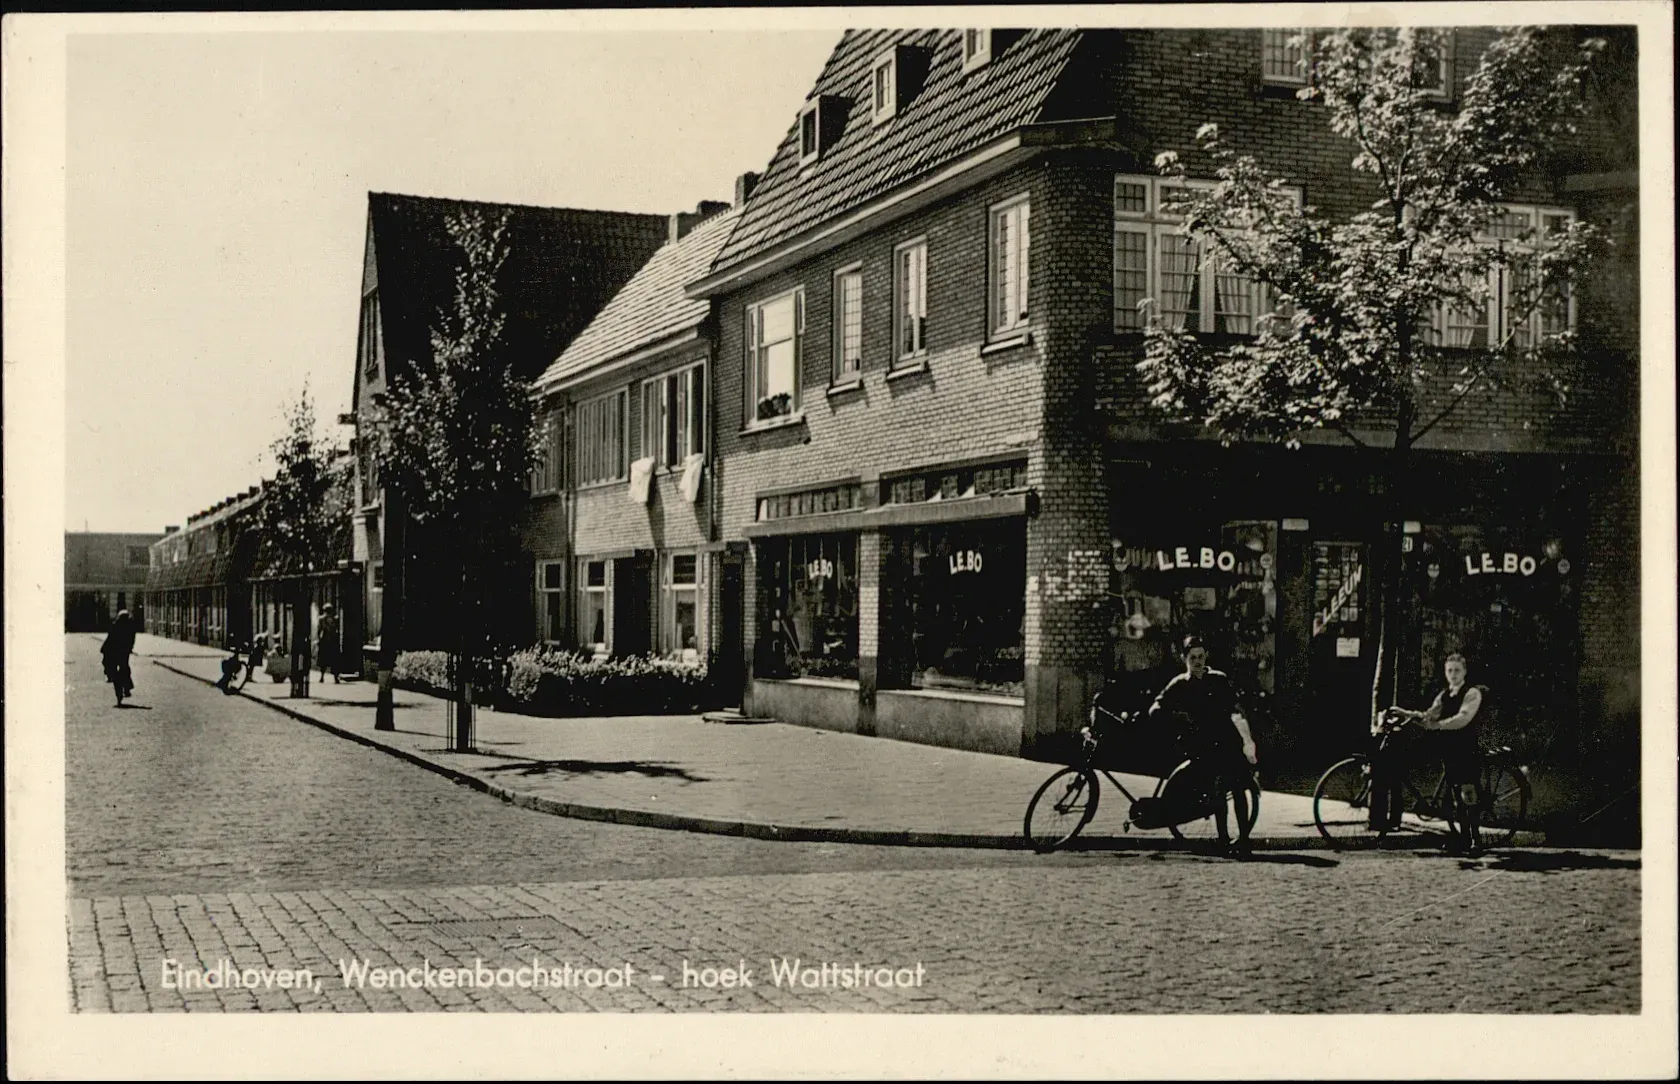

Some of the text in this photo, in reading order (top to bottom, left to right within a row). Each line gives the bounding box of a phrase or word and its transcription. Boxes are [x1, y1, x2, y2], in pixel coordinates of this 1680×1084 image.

[808, 559, 834, 580] LE.BO
[950, 550, 983, 575] LE.BO
[1157, 547, 1236, 572] LE.BO
[1465, 552, 1537, 577] LE.BO
